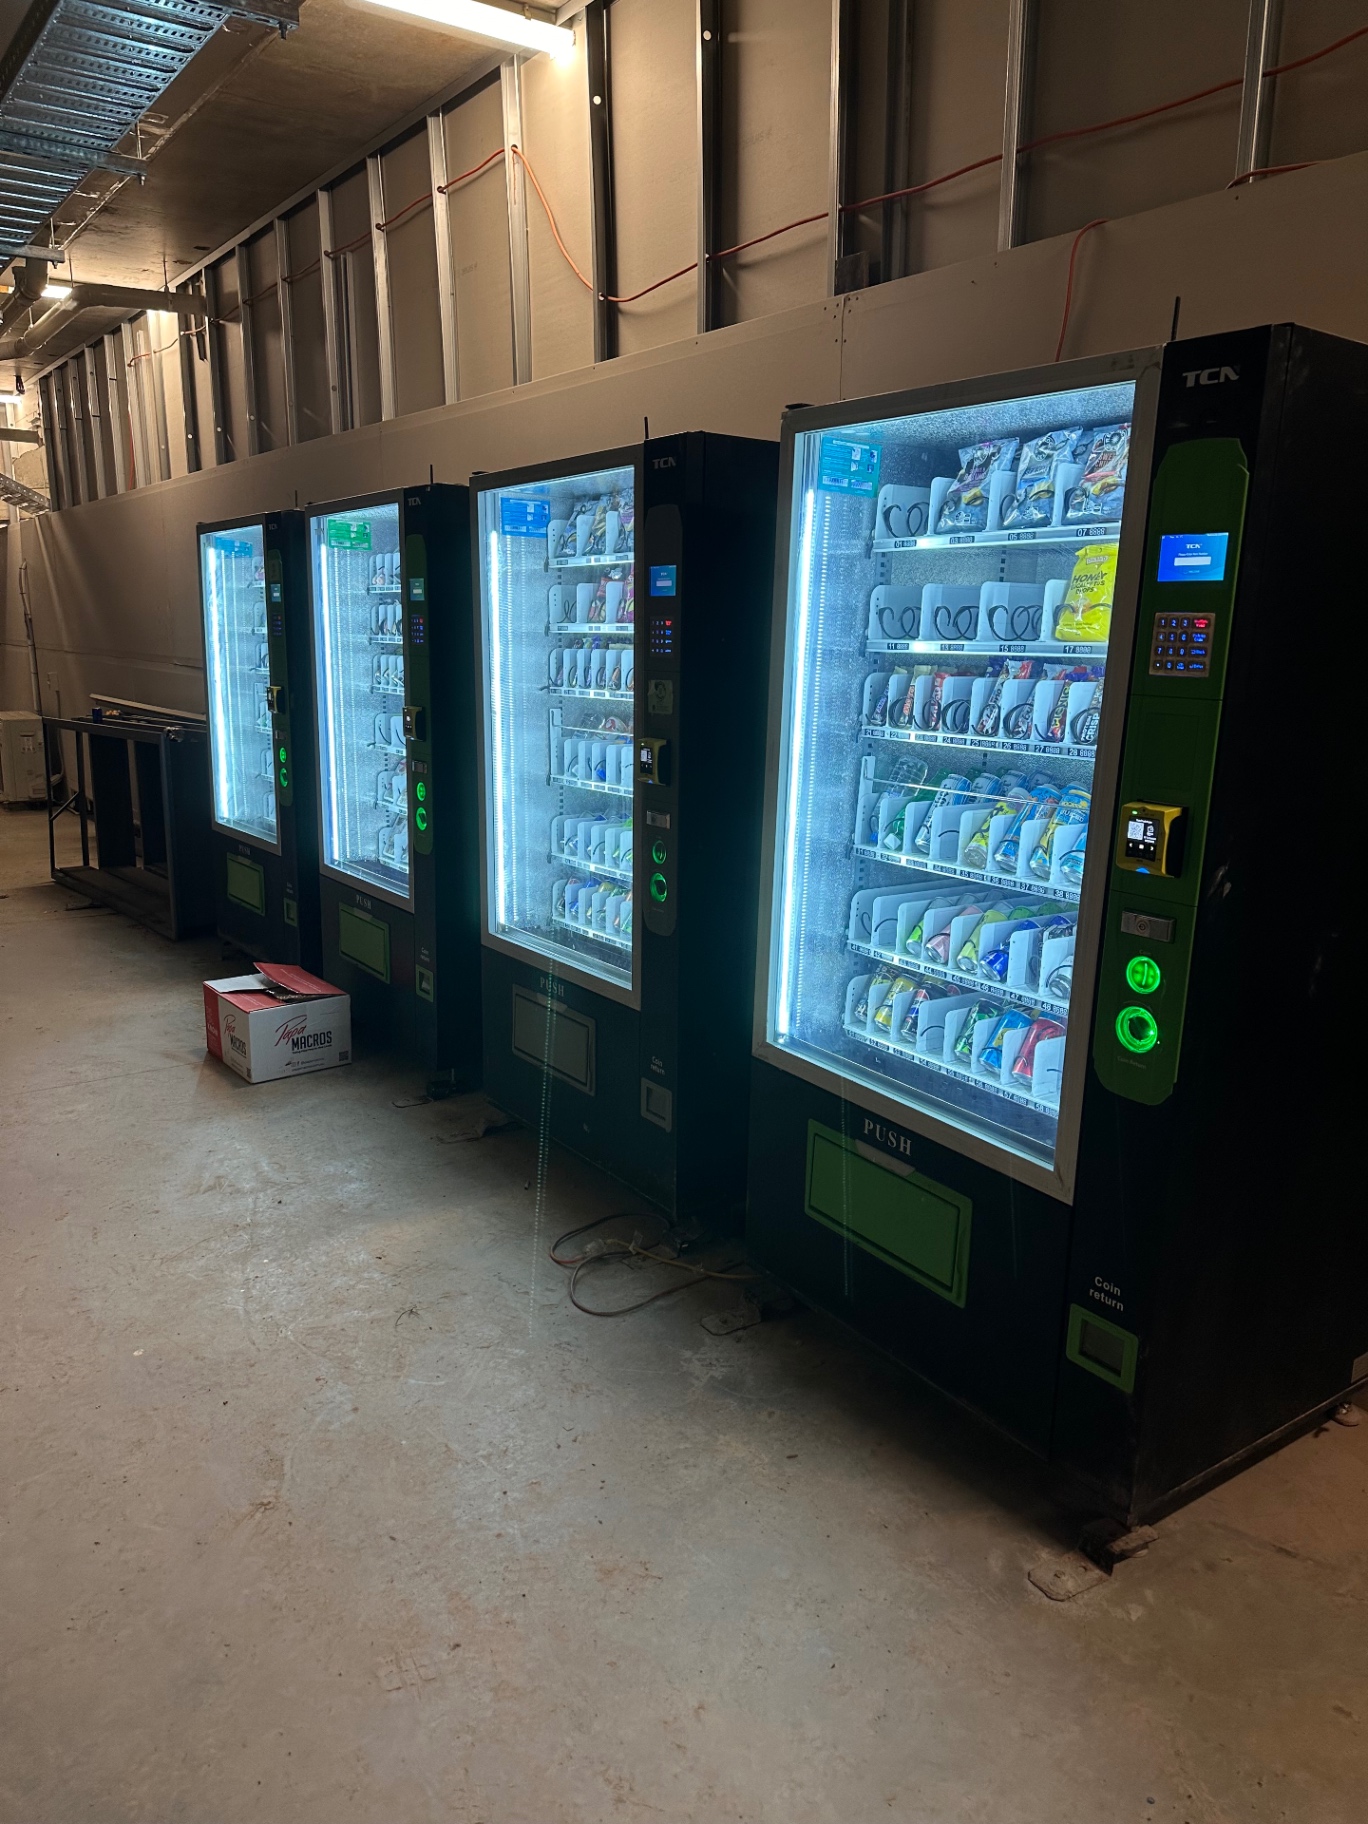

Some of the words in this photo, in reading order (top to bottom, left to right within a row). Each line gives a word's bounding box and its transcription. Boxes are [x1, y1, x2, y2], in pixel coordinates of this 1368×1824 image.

[1077, 528, 1087, 537] 07
[1072, 570, 1107, 583] HONEY
[1086, 712, 1100, 741] CRISP
[971, 739, 980, 747] 25
[1003, 742, 1012, 750] 26
[1035, 745, 1044, 753] 27
[1021, 882, 1029, 891] 37
[1055, 889, 1064, 898] 38
[355, 894, 372, 910] PUSH
[540, 976, 565, 998] PUSH
[275, 1014, 307, 1047] Papa
[292, 1030, 332, 1051] MACROS
[863, 1117, 912, 1157] PUSH
[1094, 1276, 1121, 1297] Coin
[1089, 1288, 1125, 1312] return
